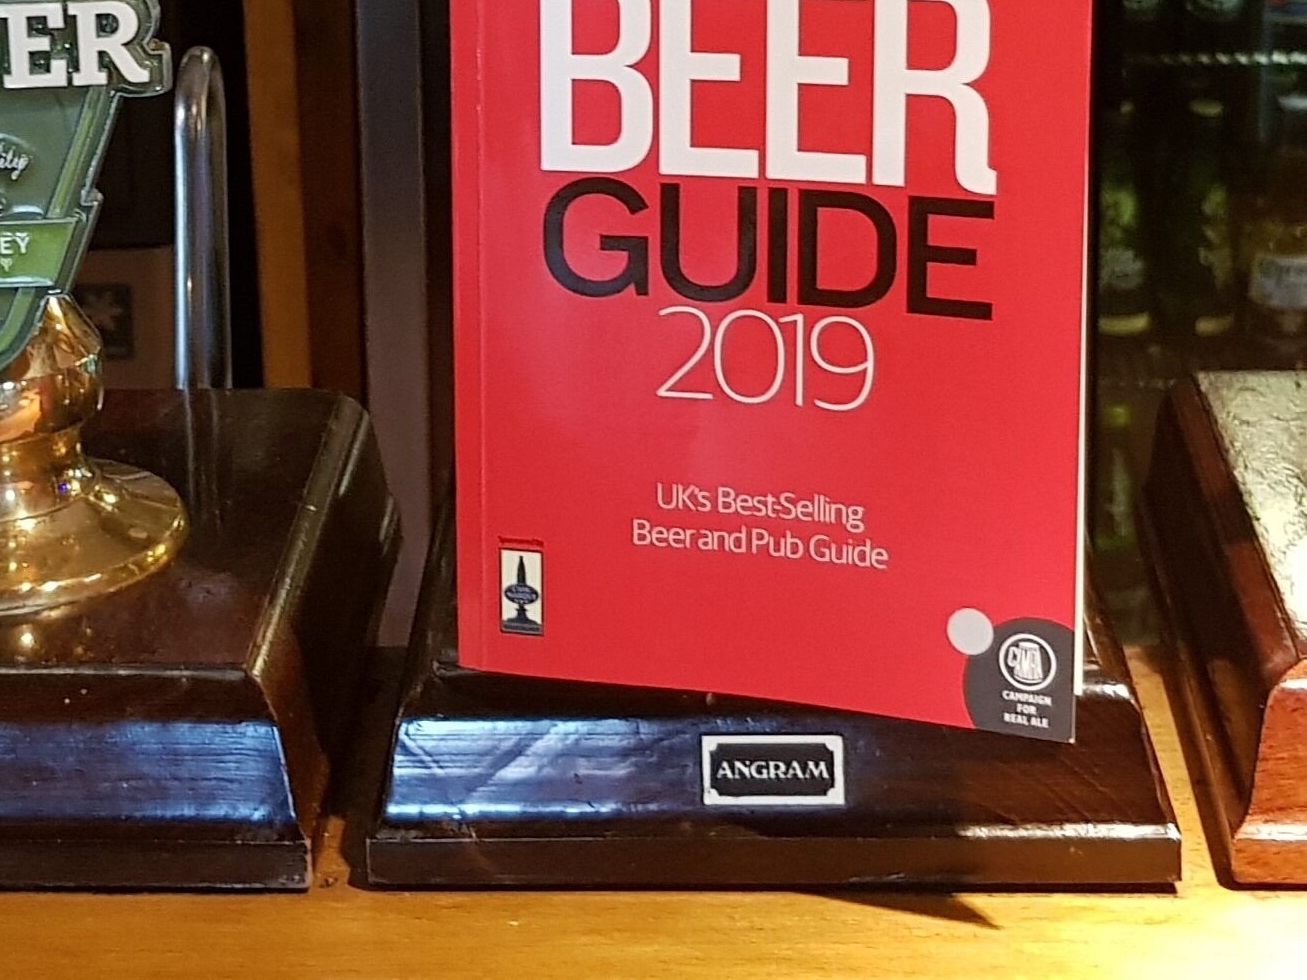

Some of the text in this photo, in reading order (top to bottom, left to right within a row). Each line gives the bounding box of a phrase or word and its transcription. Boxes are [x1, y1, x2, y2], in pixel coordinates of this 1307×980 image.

[542, 176, 995, 321] GUIDE
[656, 304, 876, 413] 2019
[656, 482, 866, 533] UK's Best-Selling
[632, 518, 889, 570] Beer and Pub Guide
[1001, 689, 1053, 707] CAMPAIGN
[1016, 703, 1038, 716] FOR
[1003, 712, 1050, 729] REAL ALE
[716, 759, 830, 779] ANGRAM
